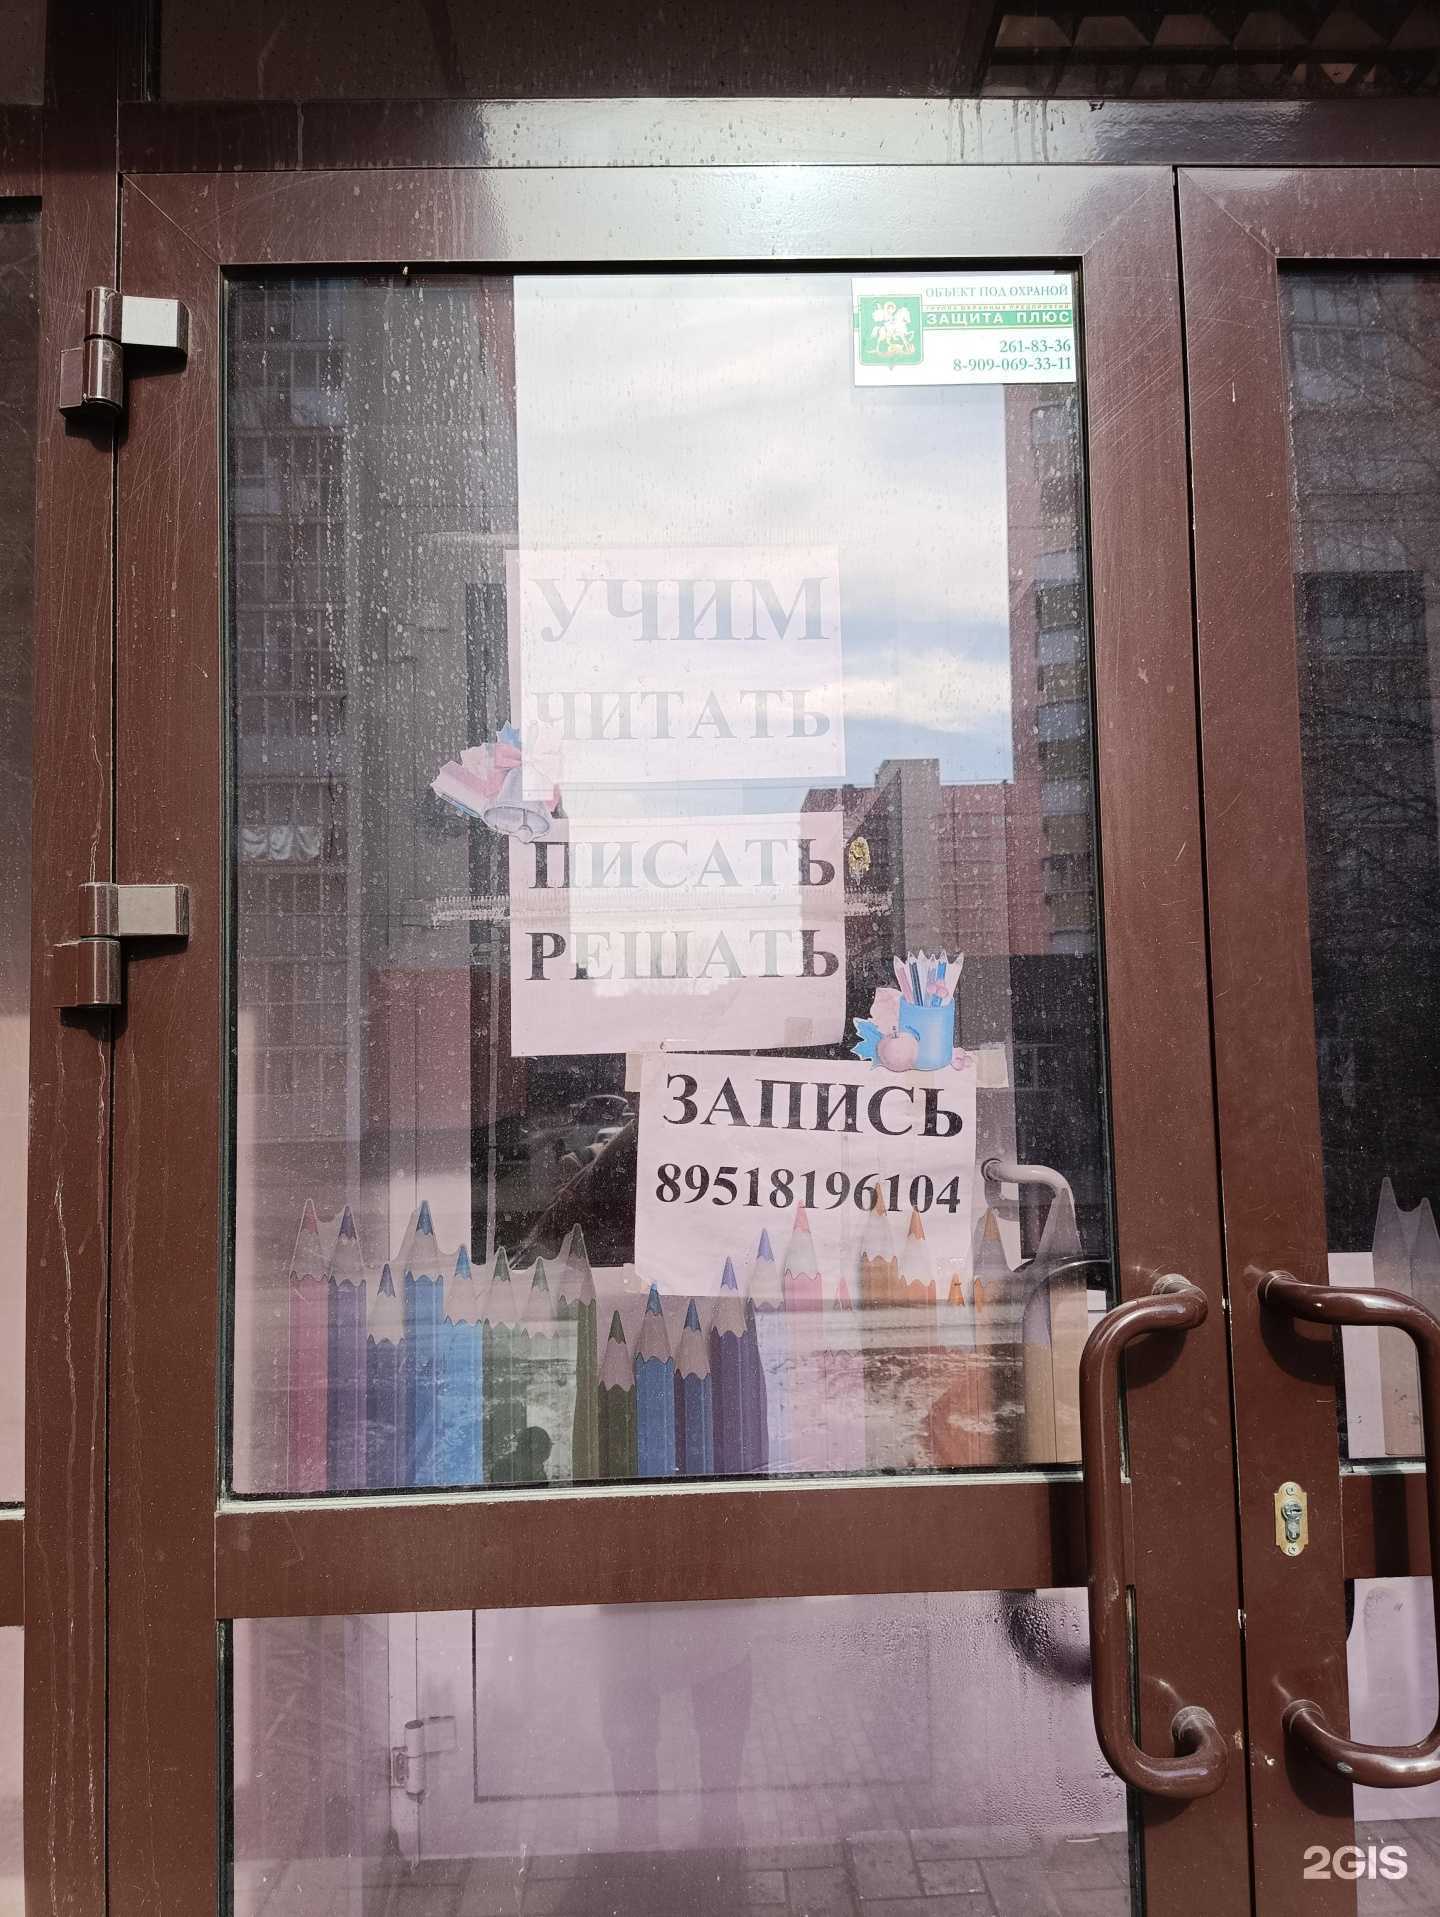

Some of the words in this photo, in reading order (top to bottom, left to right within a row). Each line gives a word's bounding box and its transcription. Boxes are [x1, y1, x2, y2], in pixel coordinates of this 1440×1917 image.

[925, 287, 976, 298] ОБЪЕКТ
[979, 287, 1006, 298] ПОД
[1009, 284, 1069, 297] ОХРАНОЙ
[927, 312, 1004, 326] ЗАЩИТА
[1016, 311, 1070, 323] ПЛЮС
[953, 357, 1072, 371] 8-909-069-33-11
[999, 338, 1072, 353] 261-83-36
[529, 577, 831, 642] УЧИМ
[533, 689, 831, 740] ЧИТАТЬ
[528, 838, 837, 889] ПИСАТЬ
[524, 930, 840, 981] РЕШАТЬ
[663, 1073, 963, 1138] ЗАПИСЬ
[655, 1163, 961, 1215] 89518196104
